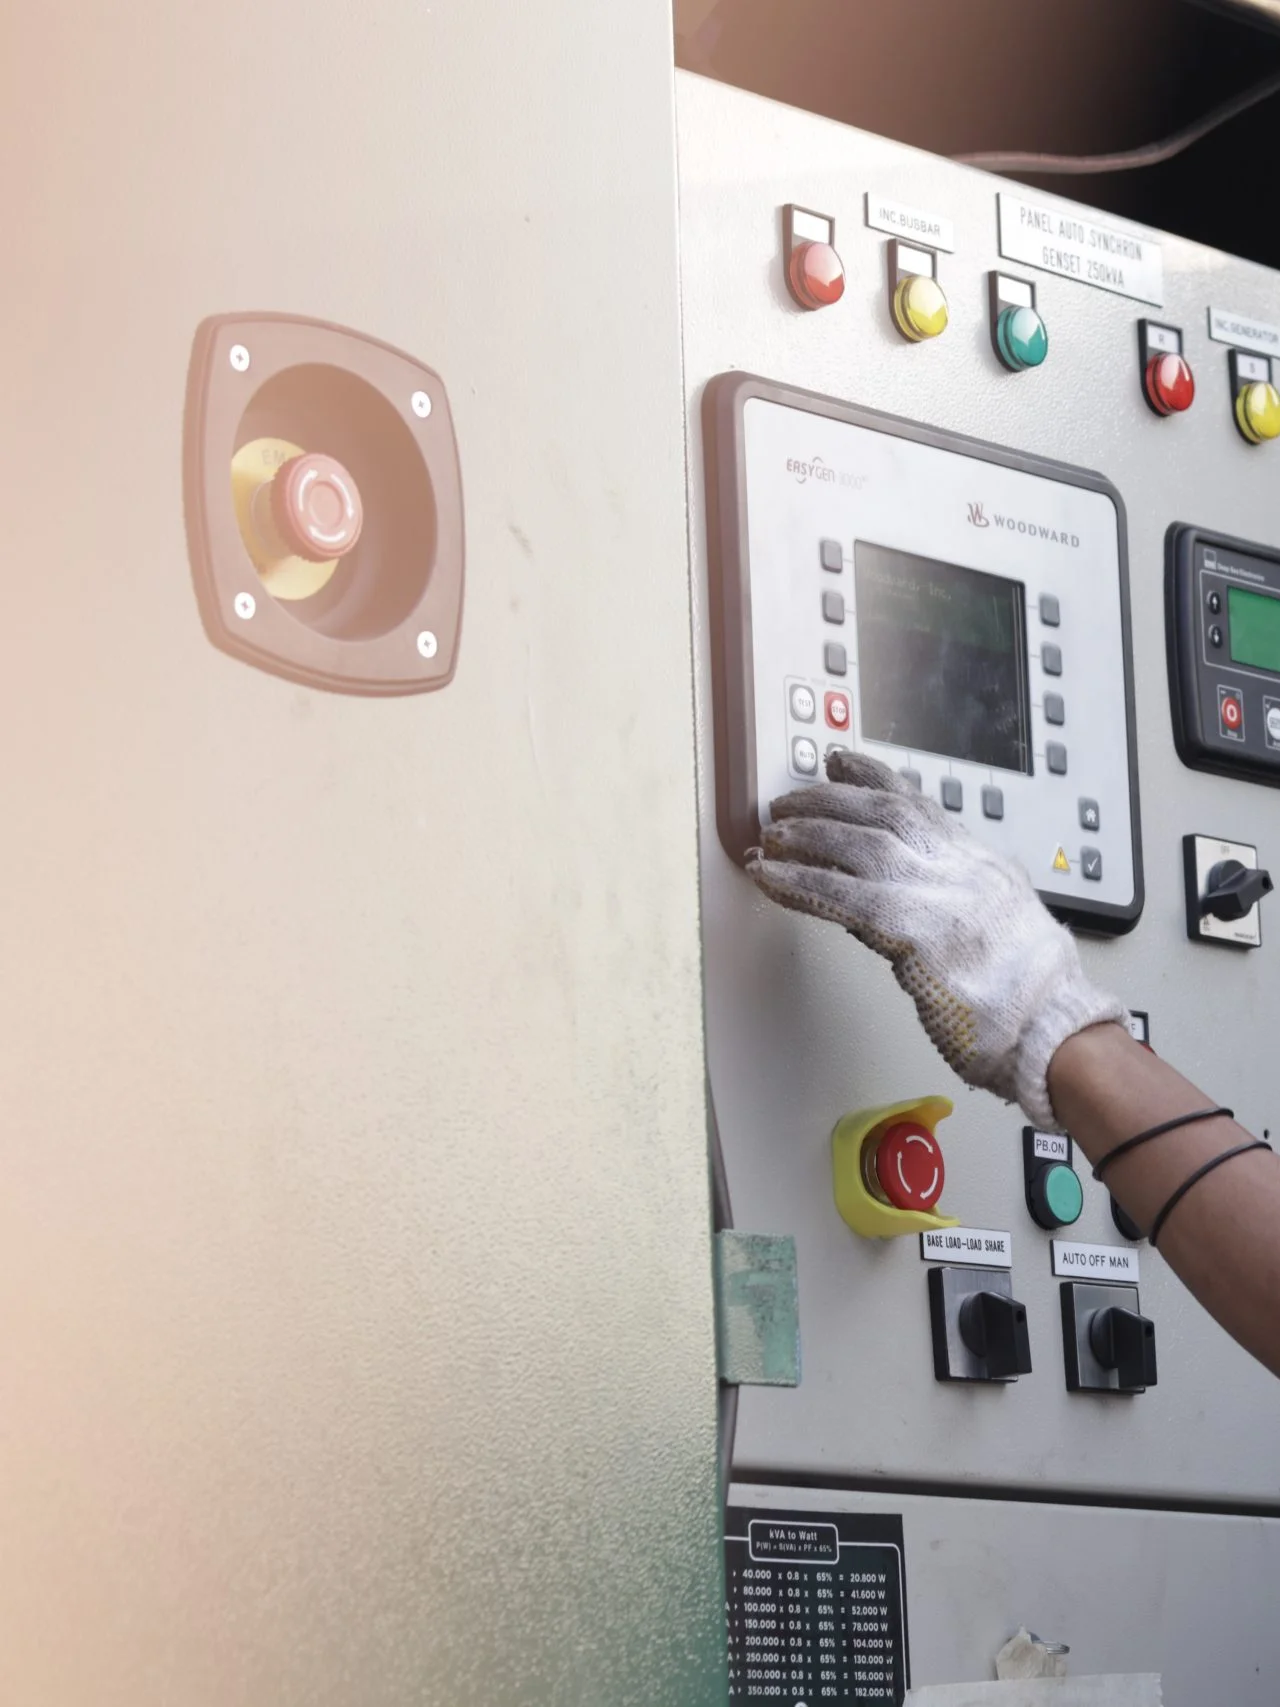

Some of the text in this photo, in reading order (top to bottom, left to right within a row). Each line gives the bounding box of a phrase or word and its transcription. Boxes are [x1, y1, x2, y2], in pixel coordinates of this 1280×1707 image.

[1020, 206, 1143, 262] PANEL AUTO SYNCHRON
[1042, 246, 1081, 273] GENSET
[1158, 333, 1165, 344] R
[994, 514, 1080, 548] WOODWARD
[1036, 1138, 1065, 1155] PB.ON
[926, 1234, 1006, 1253] BASE LOAD-LOAD SHARE
[1062, 1252, 1130, 1269] AUTO OFF MAN
[770, 1530, 817, 1540] kVA to Watt
[743, 1569, 771, 1579] 40.000
[787, 1571, 799, 1580] 0.8
[817, 1572, 832, 1581] 65%
[851, 1573, 876, 1582] 20.800
[878, 1574, 885, 1582] W
[743, 1586, 771, 1596] 80.000
[788, 1588, 800, 1597] 0.8
[817, 1589, 833, 1598] 65%
[851, 1590, 875, 1599] 41.600
[878, 1590, 885, 1599] W
[744, 1602, 776, 1612] 100.000
[789, 1604, 800, 1613] 0.8
[818, 1605, 833, 1614] 65%
[852, 1606, 878, 1615] 52.000
[880, 1607, 887, 1615] W
[745, 1619, 776, 1629] 150.000
[789, 1621, 801, 1630] 0.8
[819, 1621, 834, 1630] 65%
[853, 1622, 878, 1631] 78.000
[880, 1623, 888, 1631] W
[746, 1636, 779, 1646] 200.000
[790, 1637, 802, 1646] 0.8
[820, 1638, 835, 1647] 65%
[853, 1639, 883, 1648] 104.000
[885, 1640, 892, 1648] W
[747, 1653, 779, 1662] 250.000
[791, 1654, 802, 1663] 0.8
[820, 1654, 835, 1663] 65%
[854, 1655, 883, 1664] 130.000
[887, 1656, 893, 1664] W
[747, 1670, 780, 1679] 300.000
[791, 1670, 803, 1679] 0.8
[821, 1671, 836, 1680] 65%
[855, 1672, 884, 1680] 156.000
[886, 1672, 893, 1680] W
[748, 1686, 780, 1695] 350.000
[792, 1687, 804, 1695] 0.8
[822, 1687, 837, 1696] 65%
[855, 1688, 884, 1696] 182.000
[886, 1688, 893, 1696] W
